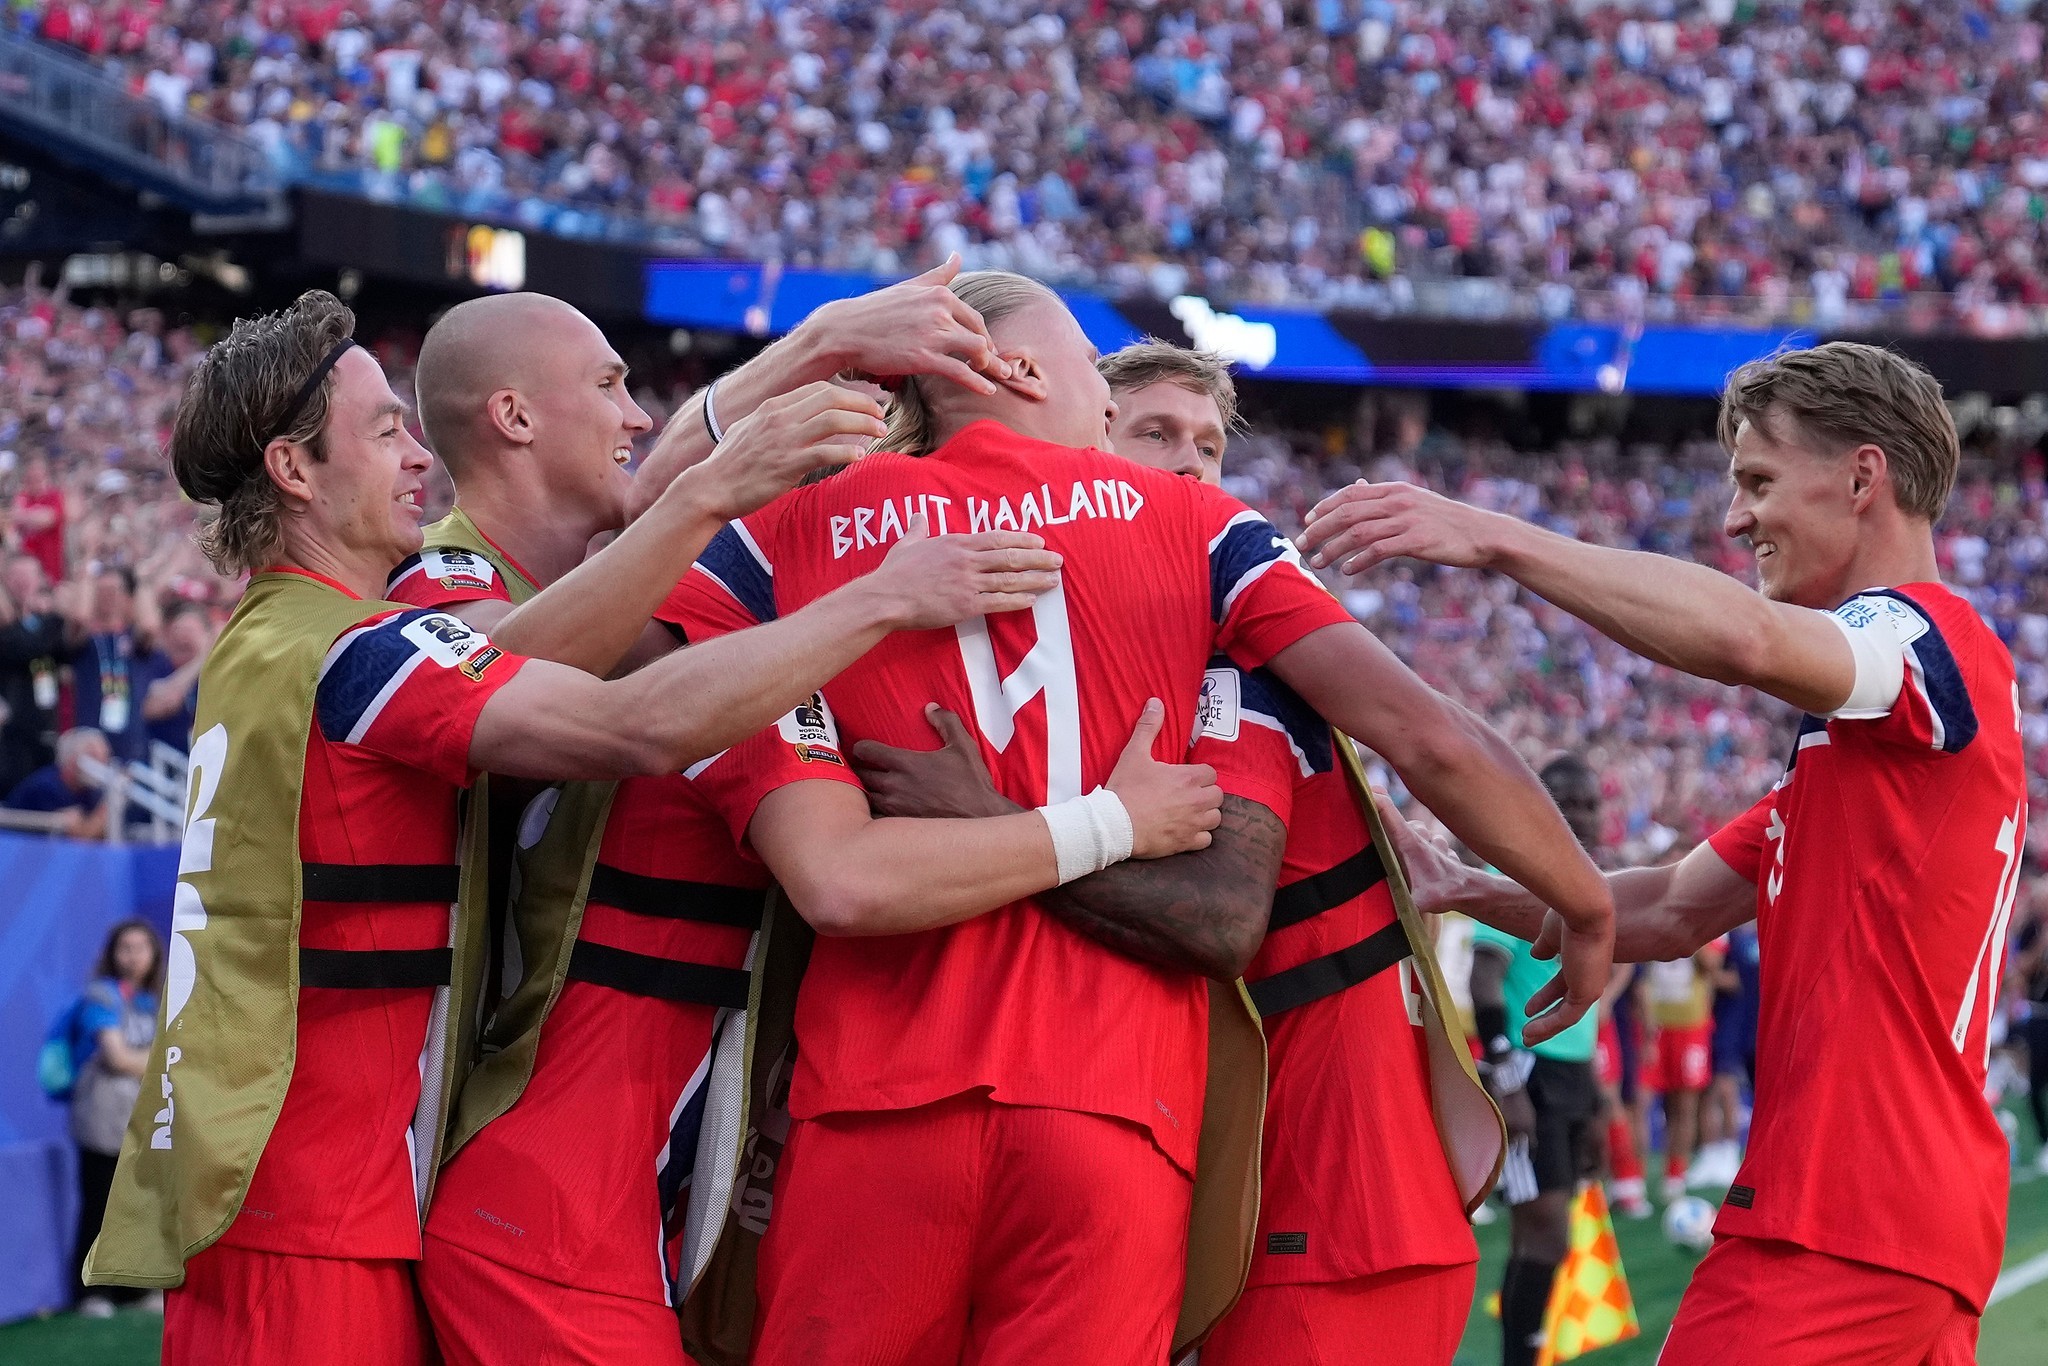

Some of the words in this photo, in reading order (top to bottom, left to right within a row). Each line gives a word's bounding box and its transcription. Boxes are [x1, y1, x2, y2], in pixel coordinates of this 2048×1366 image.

[967, 479, 1144, 535] HAALAND
[472, 648, 495, 669] DEBUT
[800, 733, 830, 742] 2026
[473, 1207, 526, 1237] AERO-FIT
